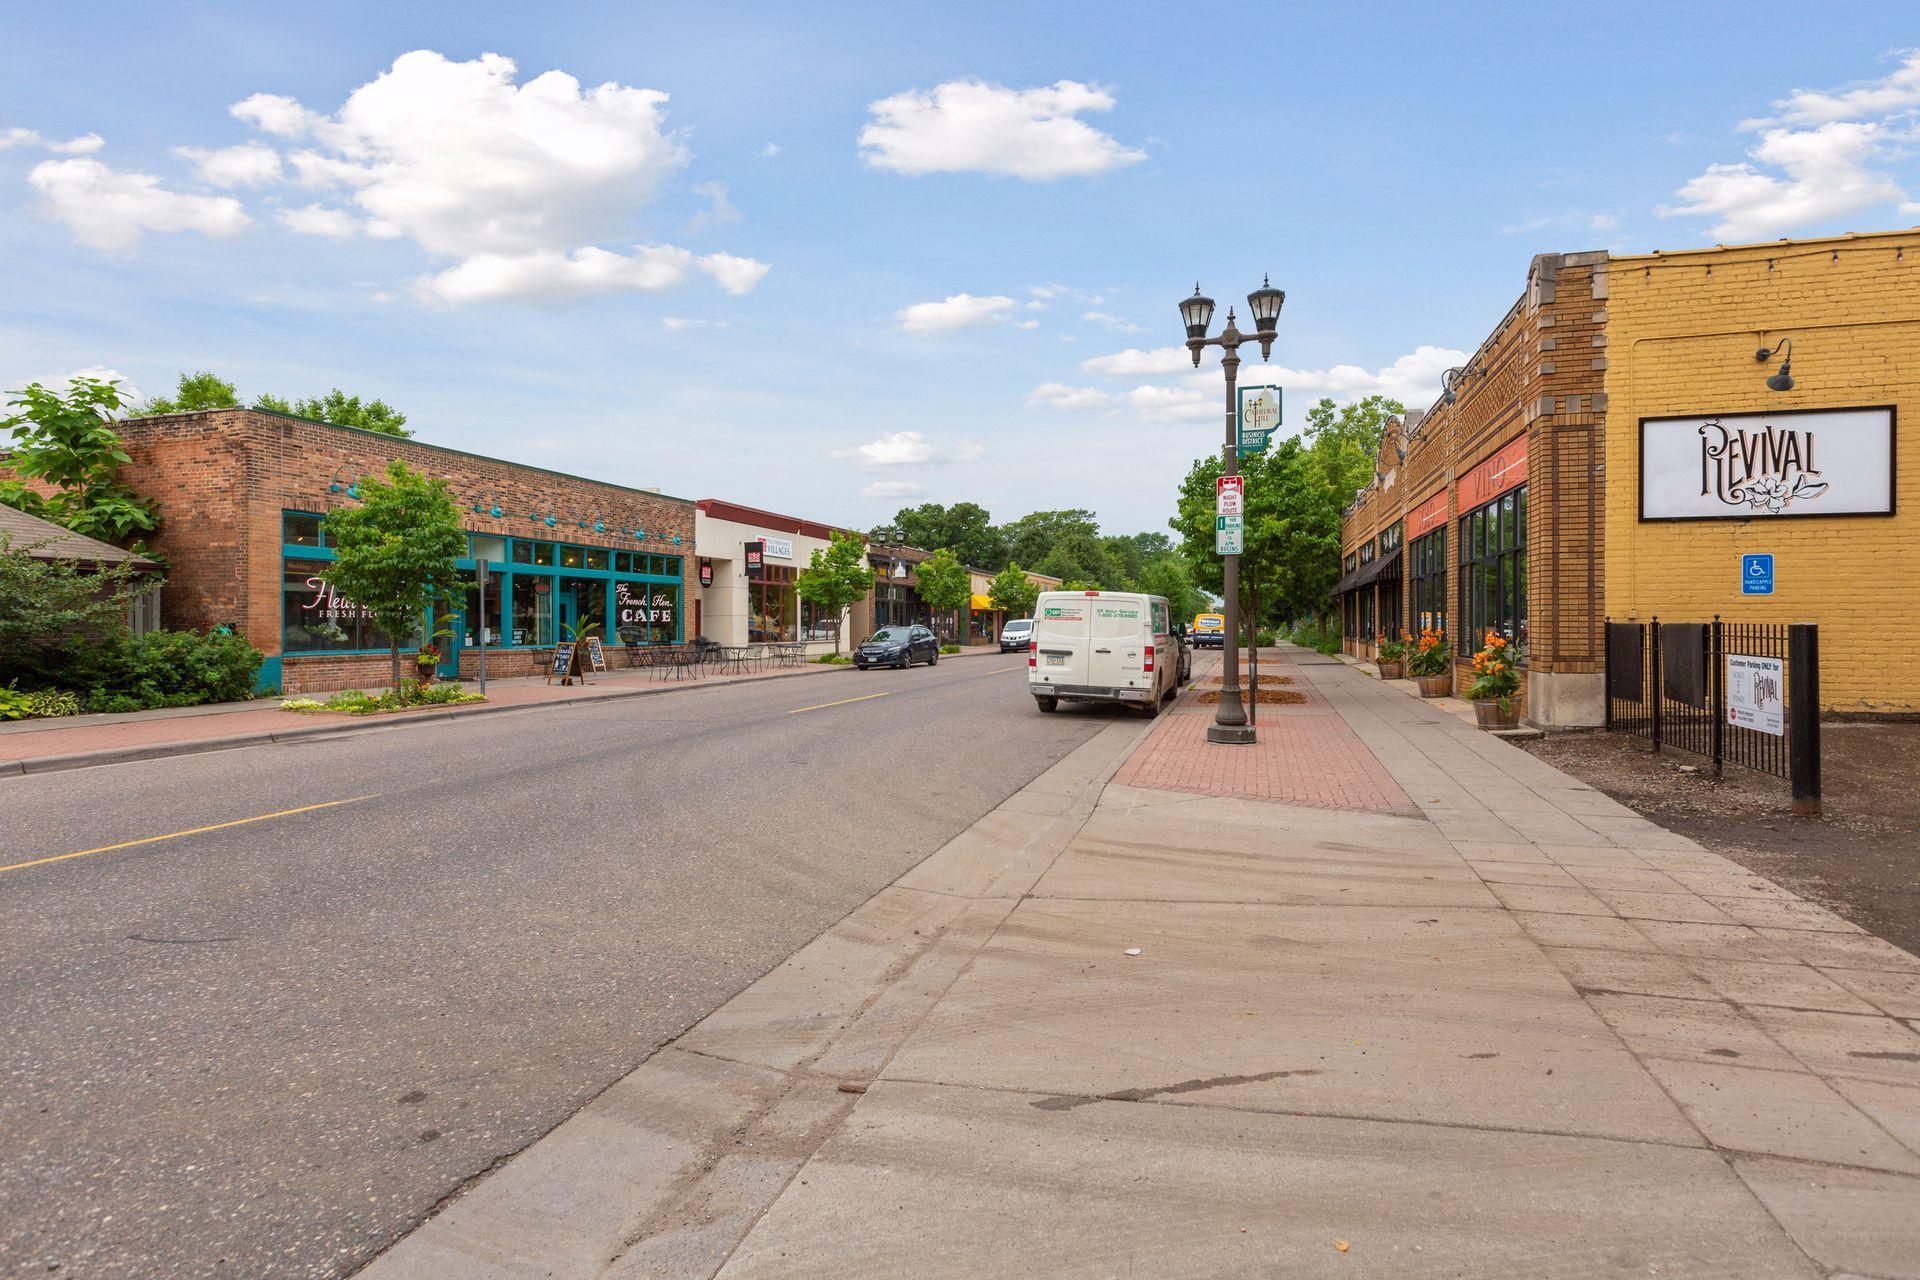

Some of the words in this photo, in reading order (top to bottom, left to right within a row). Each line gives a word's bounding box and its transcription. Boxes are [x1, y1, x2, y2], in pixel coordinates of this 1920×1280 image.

[1698, 418, 1821, 505] REVIVAL
[1474, 455, 1506, 501] VINO
[767, 545, 791, 555] VILLAGES
[618, 592, 647, 606] French
[652, 594, 673, 606] Hen
[319, 610, 356, 618] FRESH
[621, 609, 671, 622] CAFE
[1730, 659, 1747, 667] Customer
[1747, 660, 1761, 670] Parking
[1761, 662, 1772, 670] ONLY
[1772, 663, 1780, 671] for
